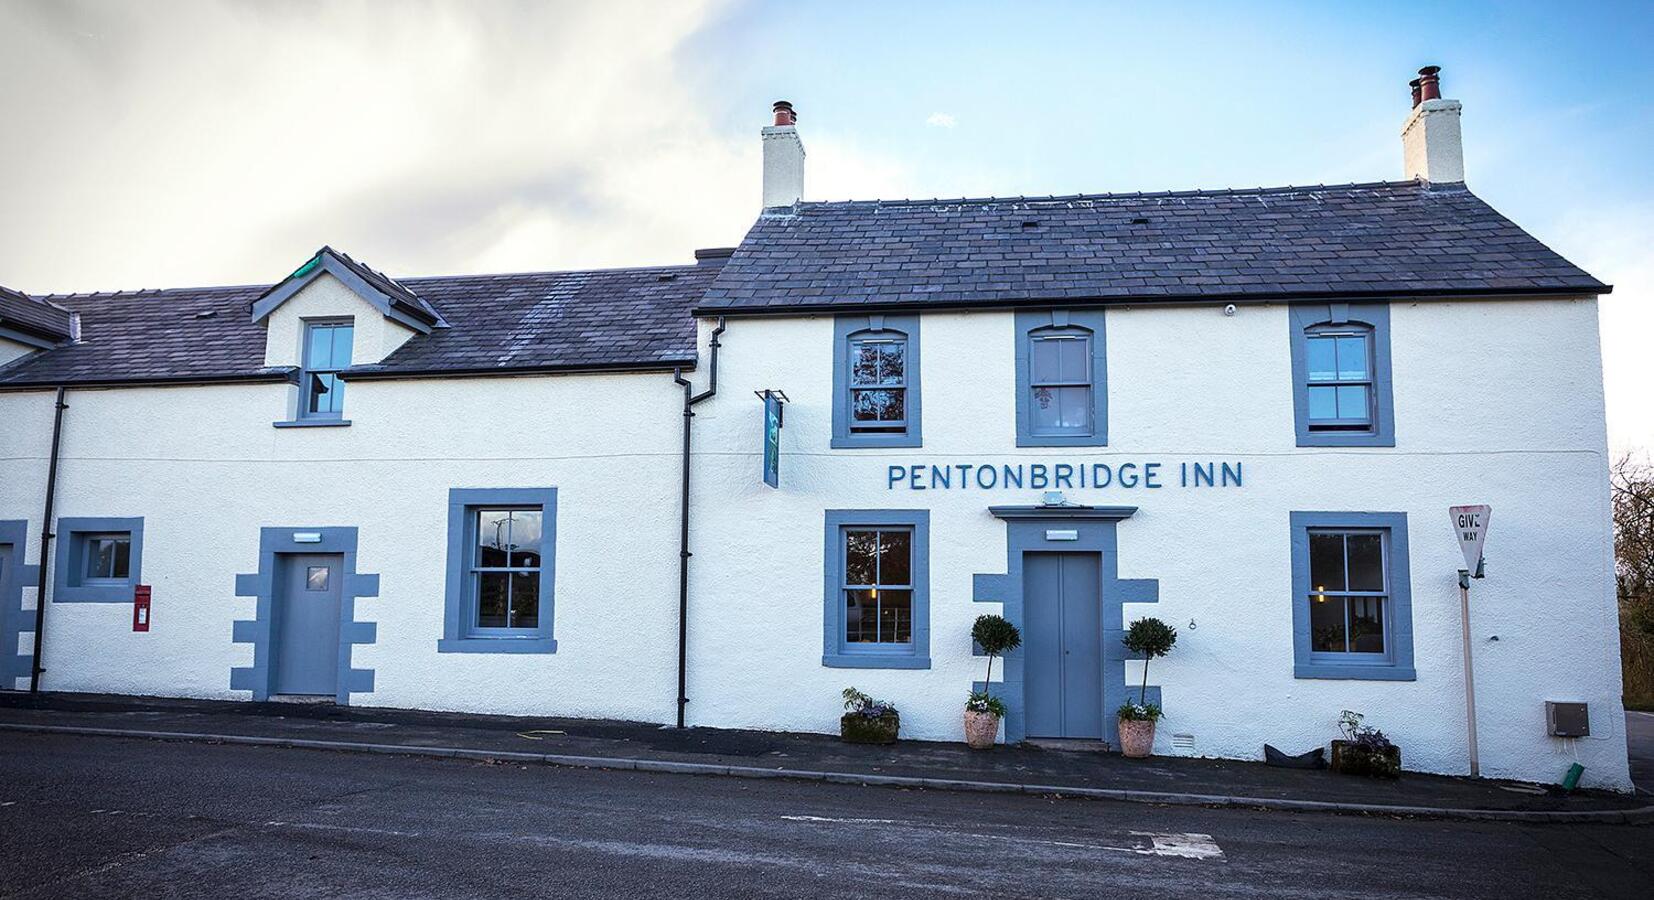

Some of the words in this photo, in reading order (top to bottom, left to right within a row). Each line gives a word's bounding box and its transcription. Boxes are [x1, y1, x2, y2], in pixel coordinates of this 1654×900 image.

[888, 463, 1162, 490] PENTONBRIDGE
[1181, 462, 1243, 488] INN
[1458, 514, 1480, 528] GIVE
[1463, 531, 1478, 541] WAY
